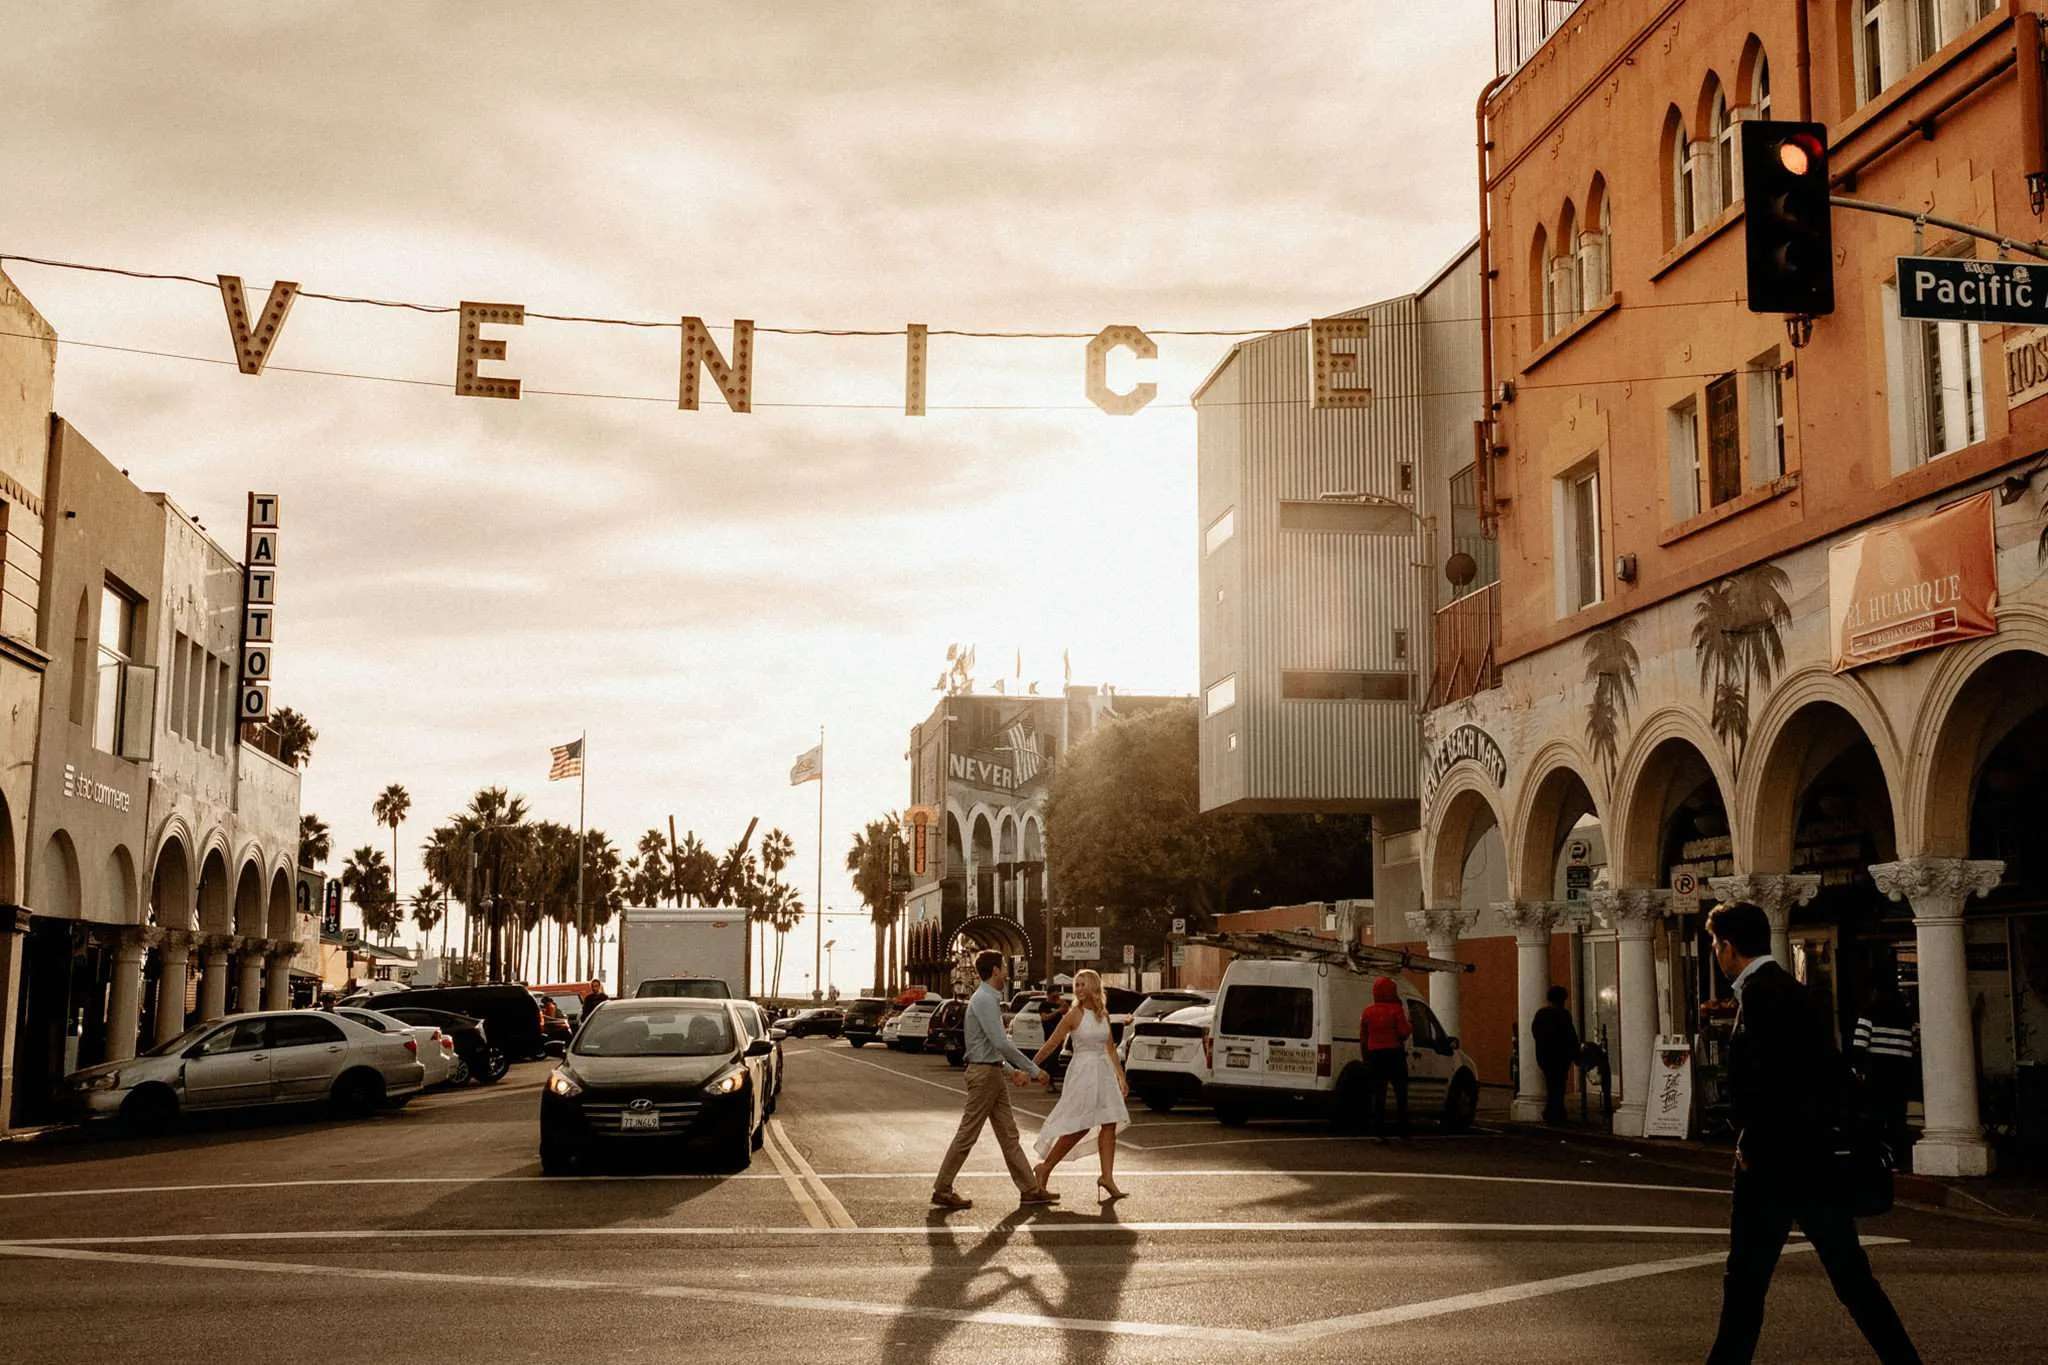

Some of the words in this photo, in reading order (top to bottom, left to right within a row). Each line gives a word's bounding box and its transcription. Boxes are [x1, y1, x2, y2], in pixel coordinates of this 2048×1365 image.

[1915, 270, 2033, 308] Pacific
[217, 274, 1371, 417] VENICE
[244, 498, 274, 714] TATTOO
[1869, 575, 1961, 622] HUARIQUE
[949, 752, 1013, 790] NEVER
[1446, 727, 1475, 764] BEACH
[1477, 732, 1505, 790] MART
[1065, 931, 1096, 940] PUBLIC
